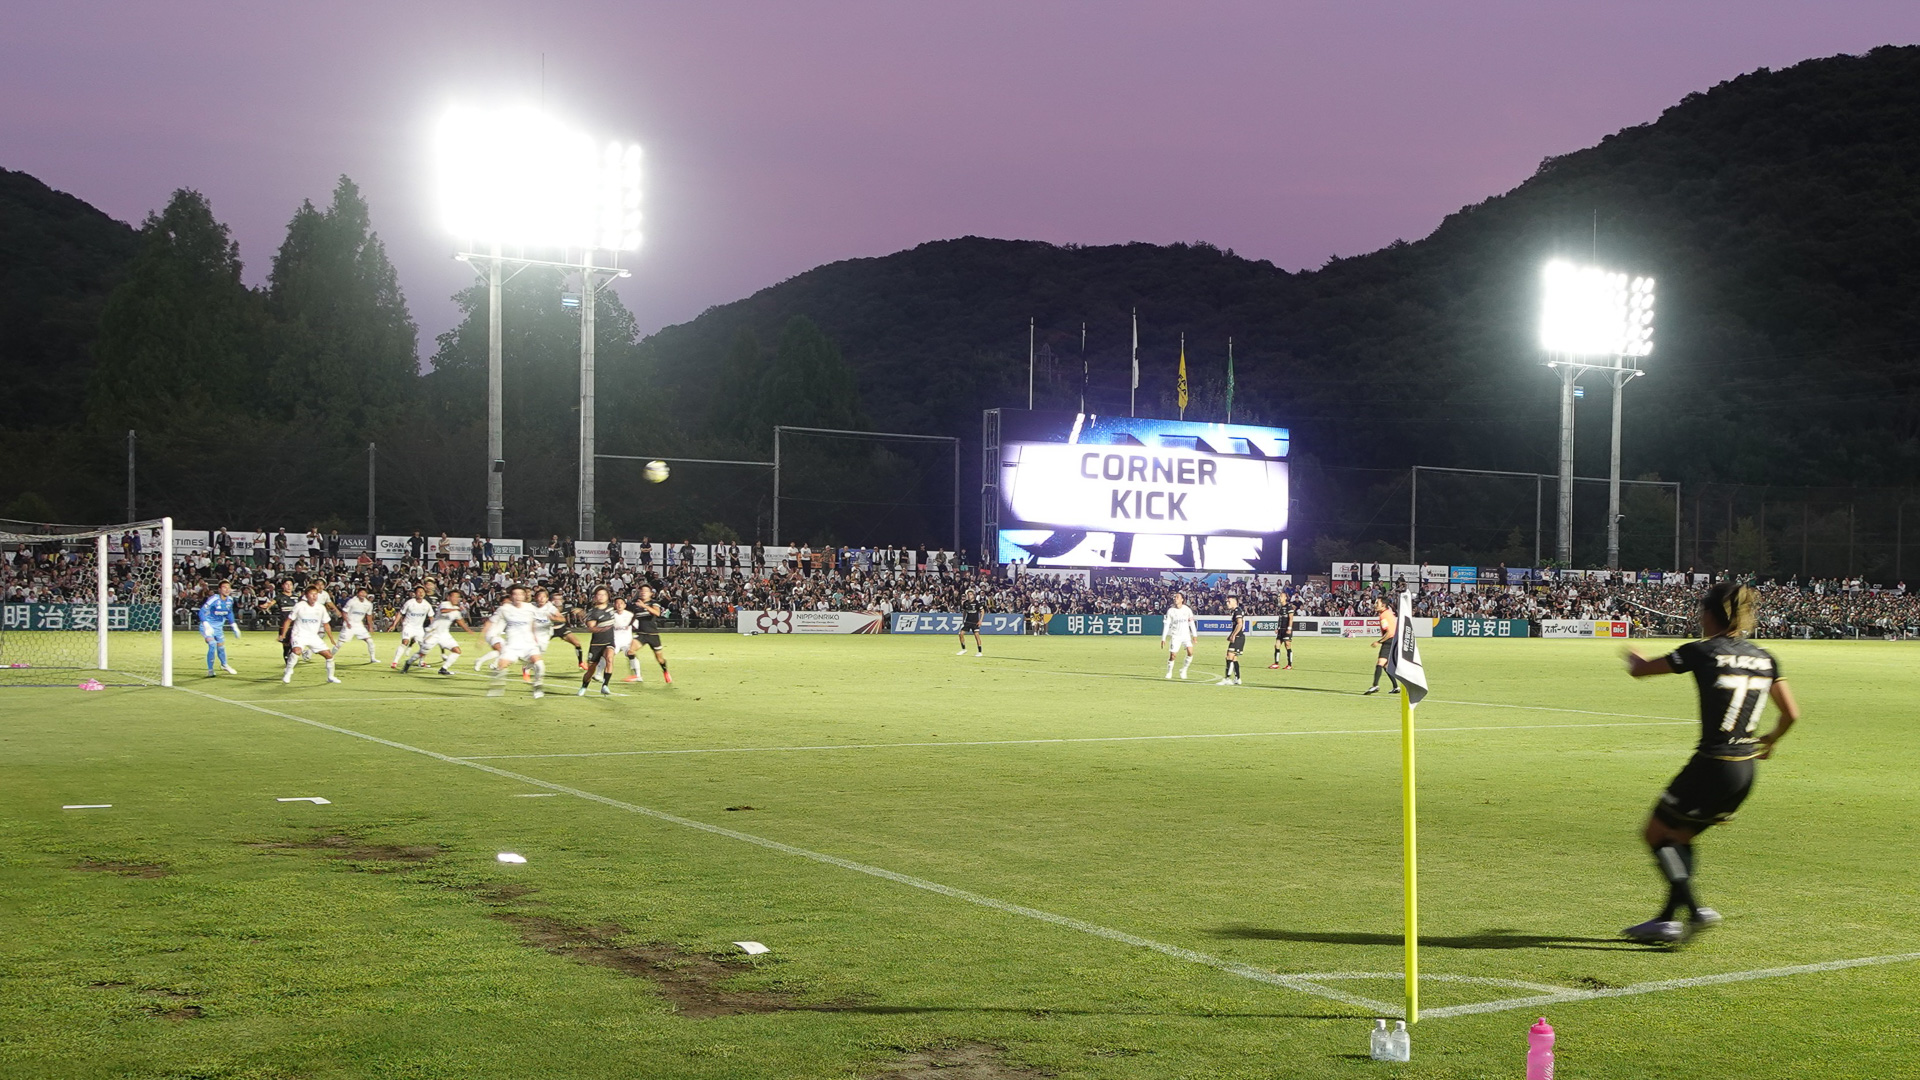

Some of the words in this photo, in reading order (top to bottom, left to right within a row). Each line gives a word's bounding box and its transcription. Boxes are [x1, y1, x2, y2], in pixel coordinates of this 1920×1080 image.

[1080, 452, 1218, 486] CORNER
[1110, 489, 1188, 522] KICK
[3, 604, 130, 630] 明治安田
[919, 616, 1022, 632] エステーワイ
[1067, 615, 1142, 635] 明治安田
[1451, 619, 1511, 637] 明治安田
[1544, 623, 1578, 634] スポーツくじ
[1713, 673, 1774, 733] 77
